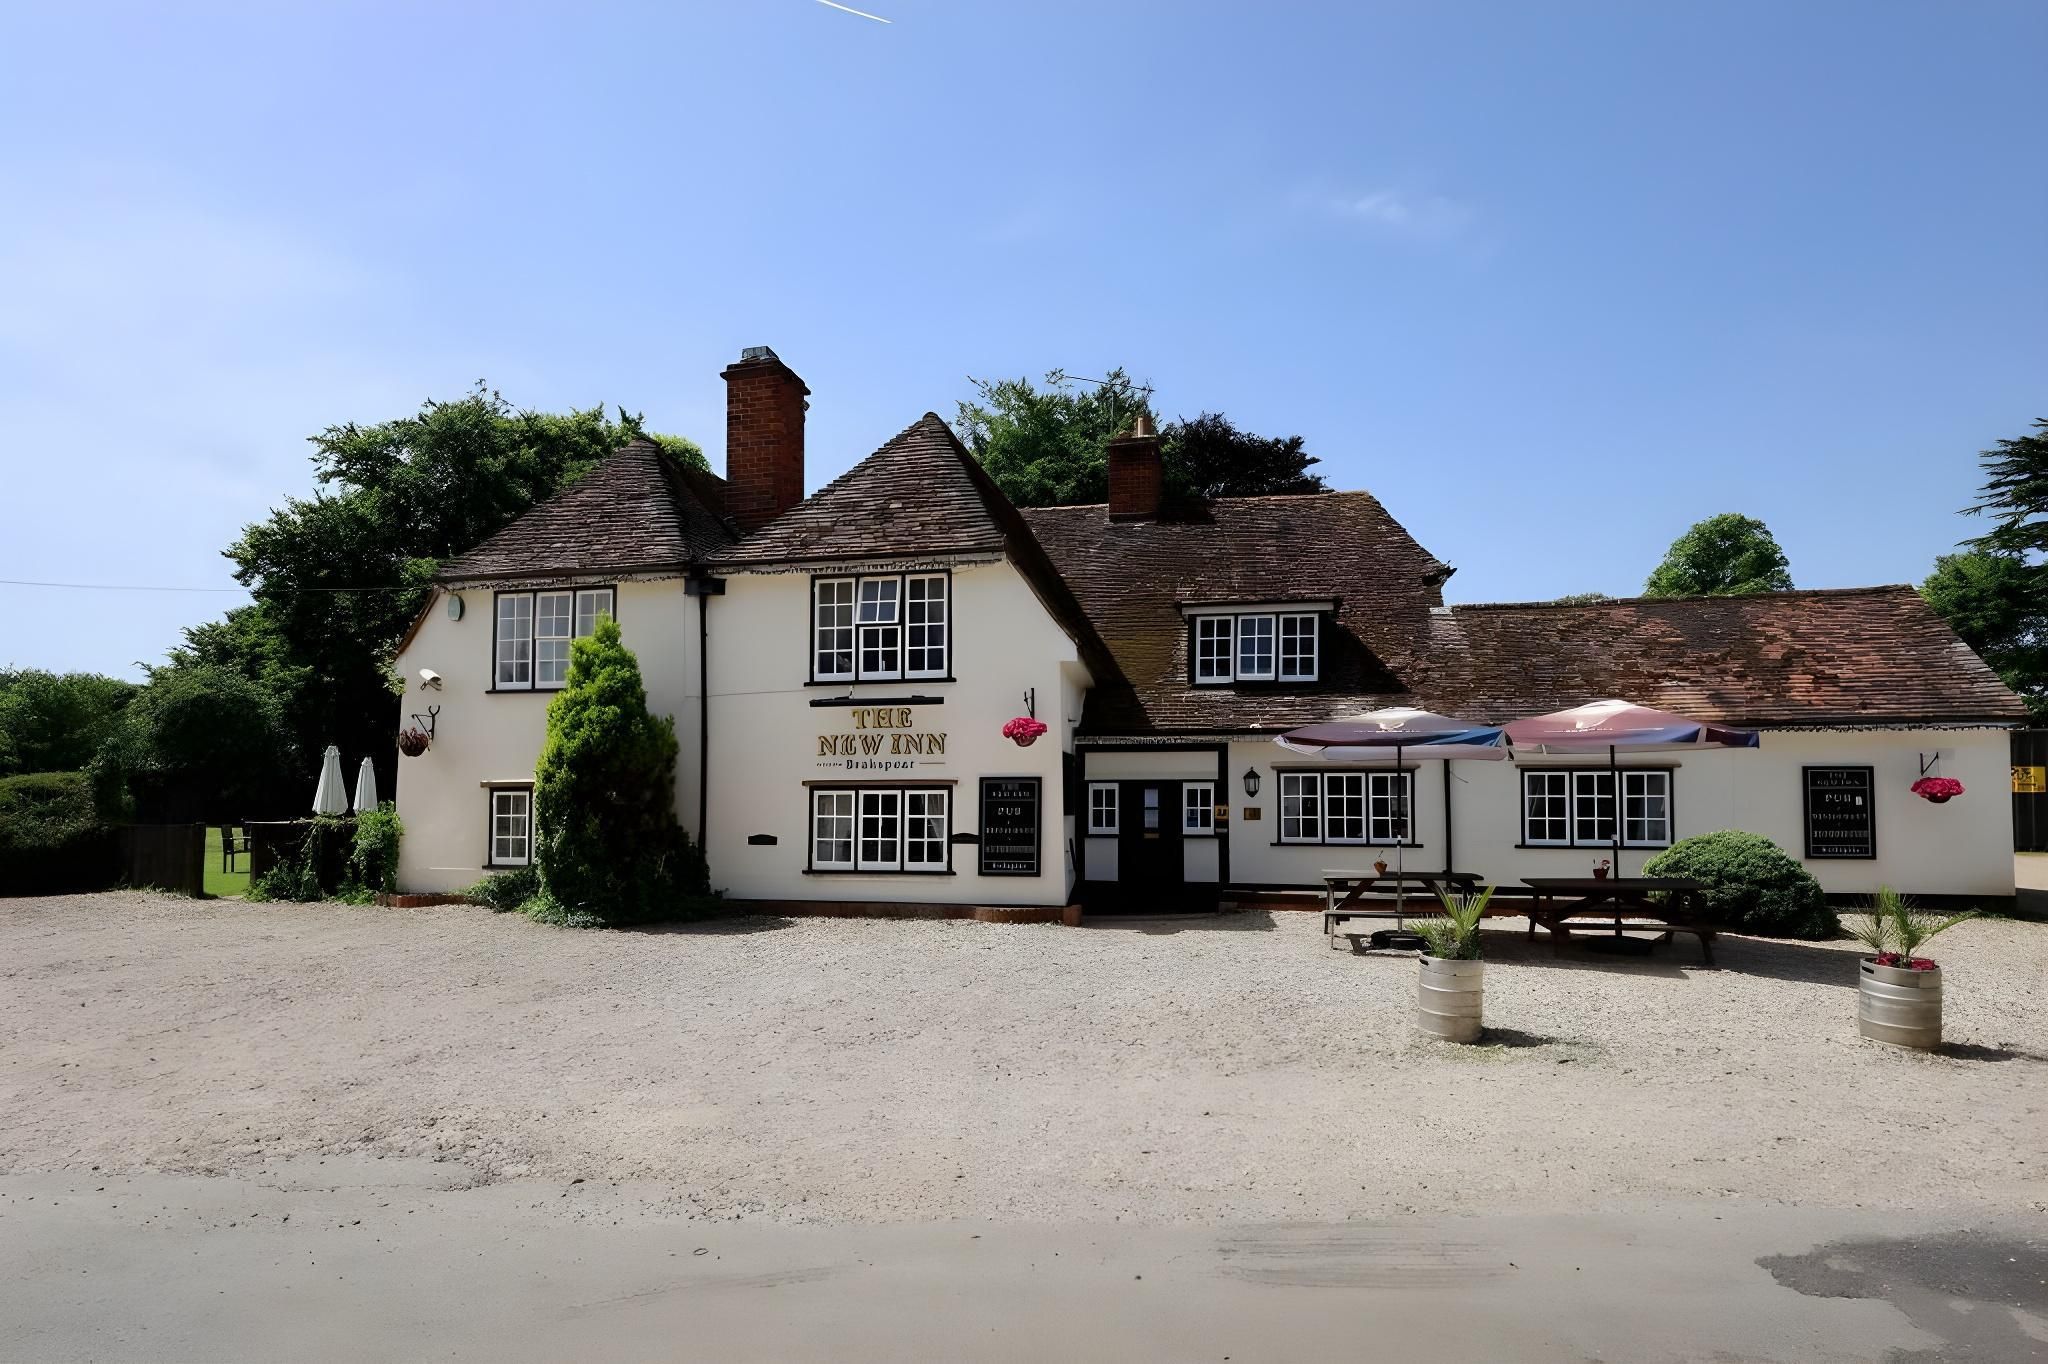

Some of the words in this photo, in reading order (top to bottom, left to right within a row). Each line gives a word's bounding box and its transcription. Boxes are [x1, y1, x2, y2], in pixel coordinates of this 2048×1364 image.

[852, 707, 913, 730] THE
[817, 734, 884, 756] NEW
[890, 732, 947, 755] INN
